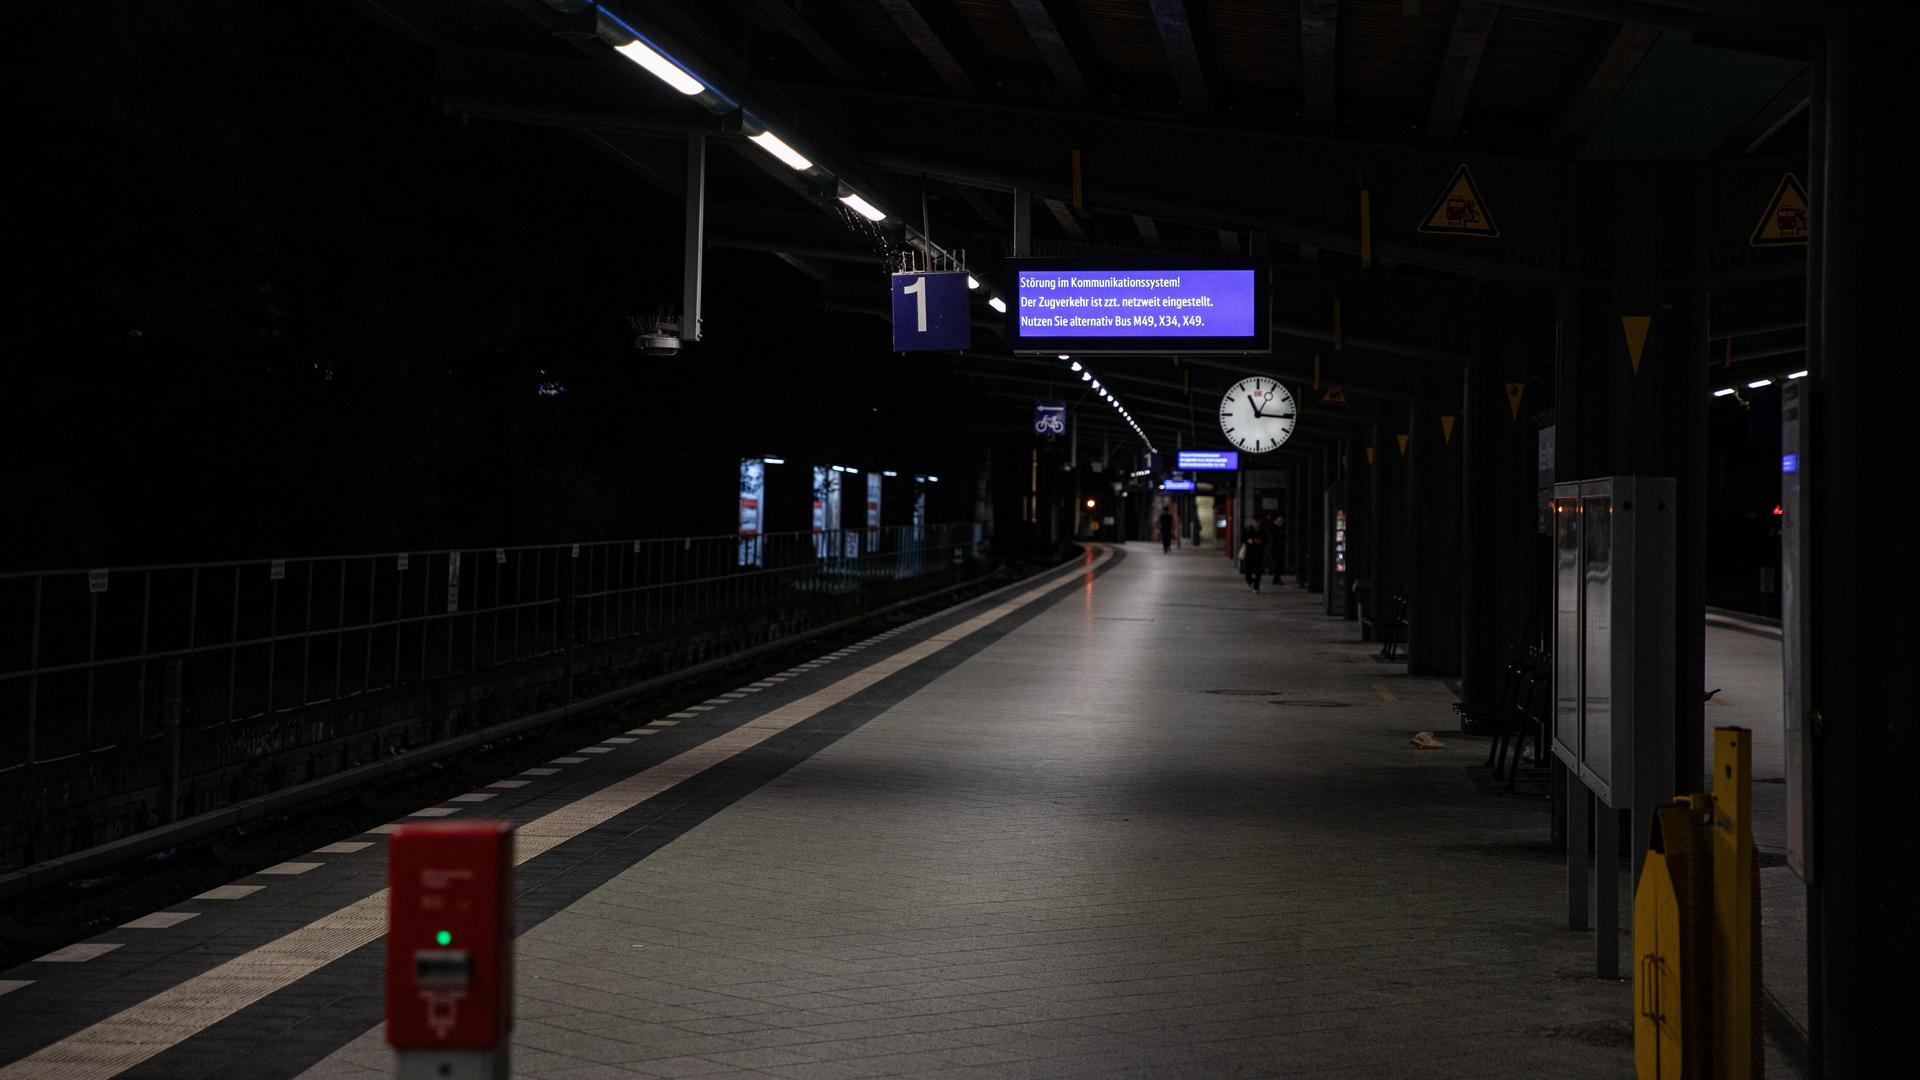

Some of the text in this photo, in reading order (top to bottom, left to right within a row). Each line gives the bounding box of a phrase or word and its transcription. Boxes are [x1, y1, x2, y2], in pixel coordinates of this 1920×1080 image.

[1020, 277, 1181, 291] Störung im Kommunikationssystem!
[903, 277, 928, 332] 1
[1021, 296, 1213, 310] Der Zugverkehr ist zzt. netzweit eingestellt.
[1021, 315, 1204, 328] Nutzen Sie alternativ Bus M49, X34, X49.
